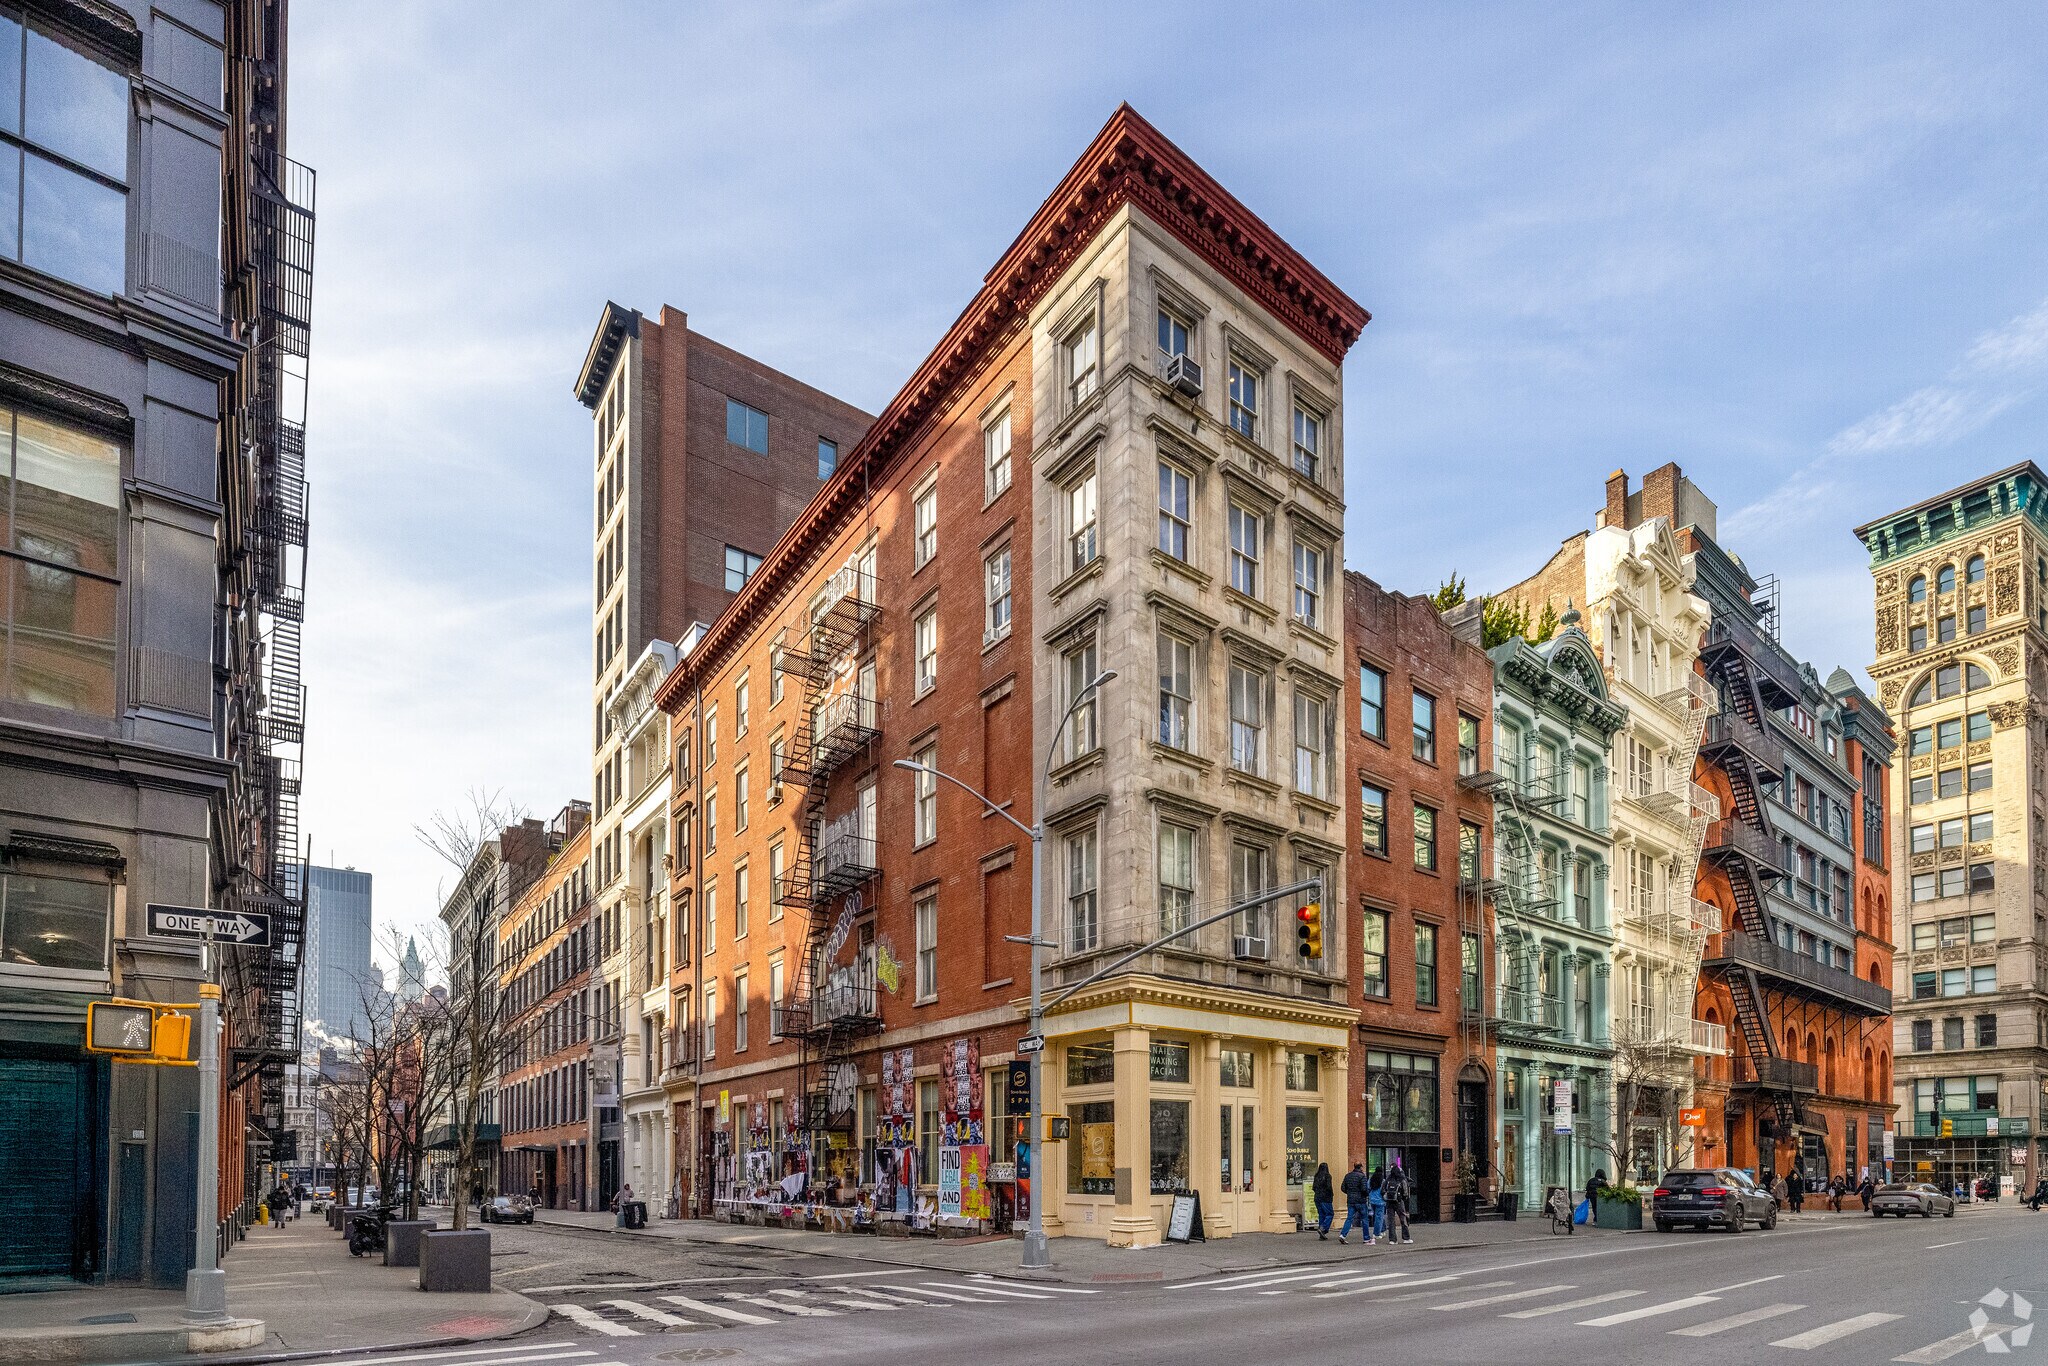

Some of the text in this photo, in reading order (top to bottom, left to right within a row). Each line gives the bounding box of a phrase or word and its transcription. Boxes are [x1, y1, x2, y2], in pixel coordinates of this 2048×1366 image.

[166, 916, 251, 934] ONE WAY
[1152, 1047, 1176, 1056] NAILS
[1150, 1057, 1178, 1066] WAXING
[1151, 1067, 1177, 1076] FACIAL
[1227, 1063, 1244, 1076] 429
[942, 1150, 960, 1169] FIND
[942, 1170, 960, 1184] LEGAL
[942, 1191, 960, 1203] AND
